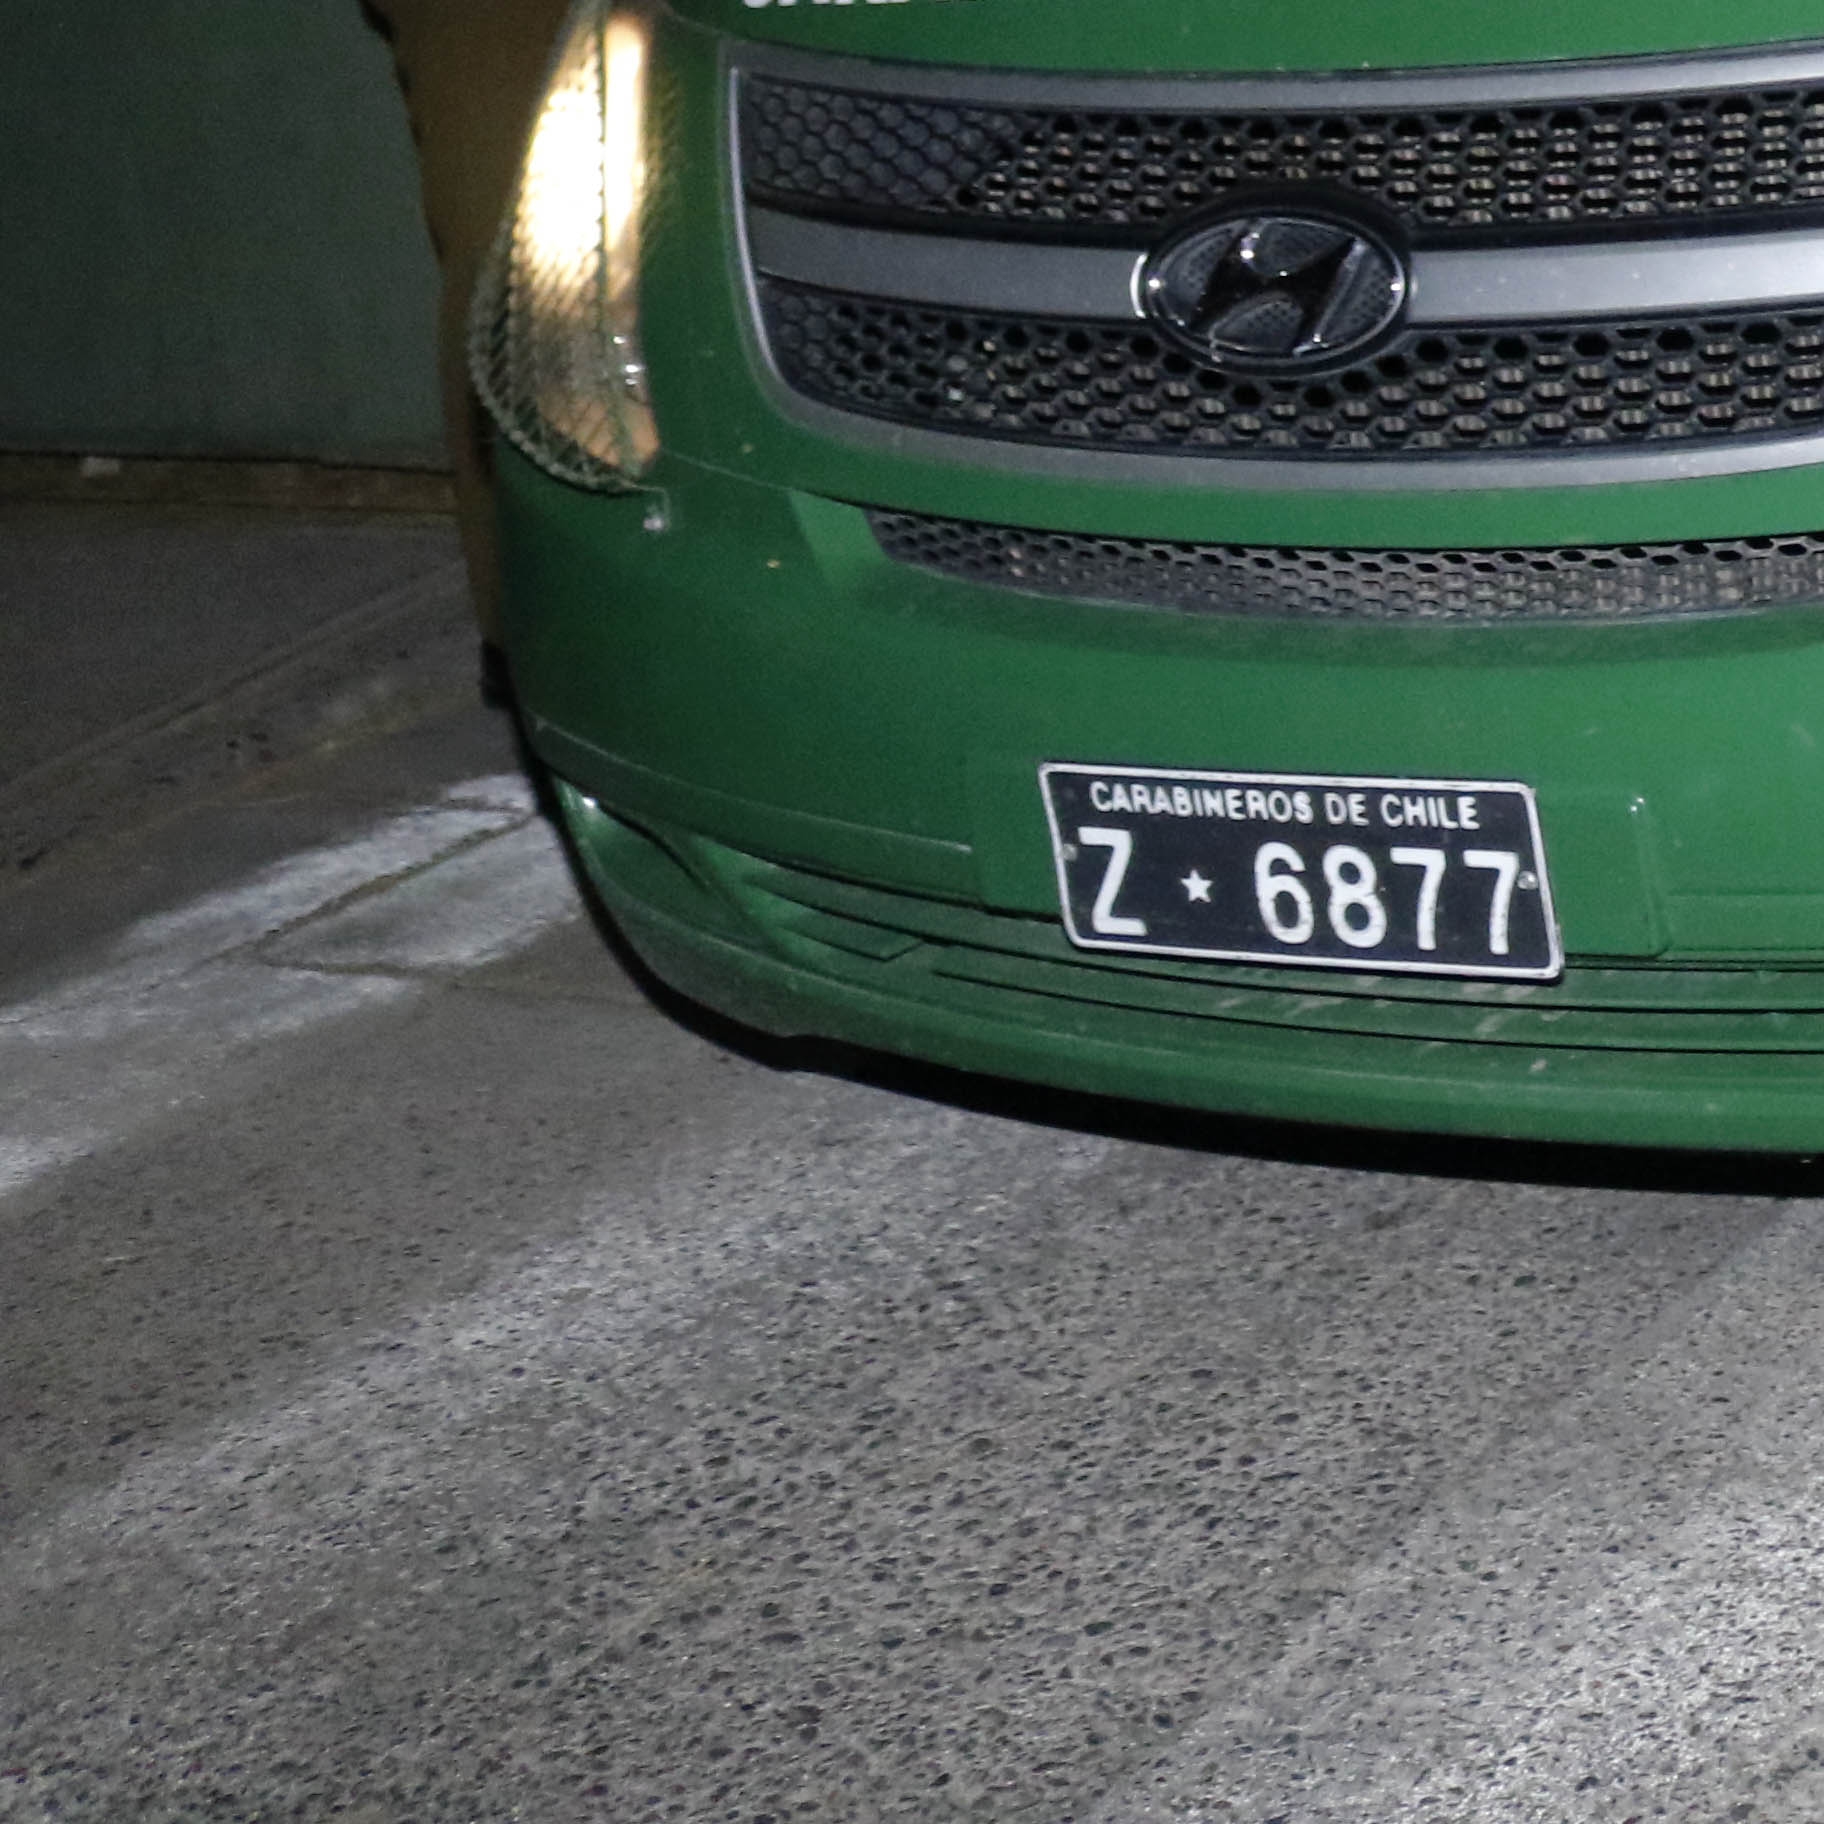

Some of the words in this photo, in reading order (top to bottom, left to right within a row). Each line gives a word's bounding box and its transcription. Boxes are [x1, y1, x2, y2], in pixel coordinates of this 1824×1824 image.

[1090, 781, 1314, 824] CARABINEROS
[1324, 792, 1369, 826] DE
[1380, 793, 1480, 830] CHILE
[1078, 826, 1147, 936] Z
[1254, 841, 1520, 955] 6877
